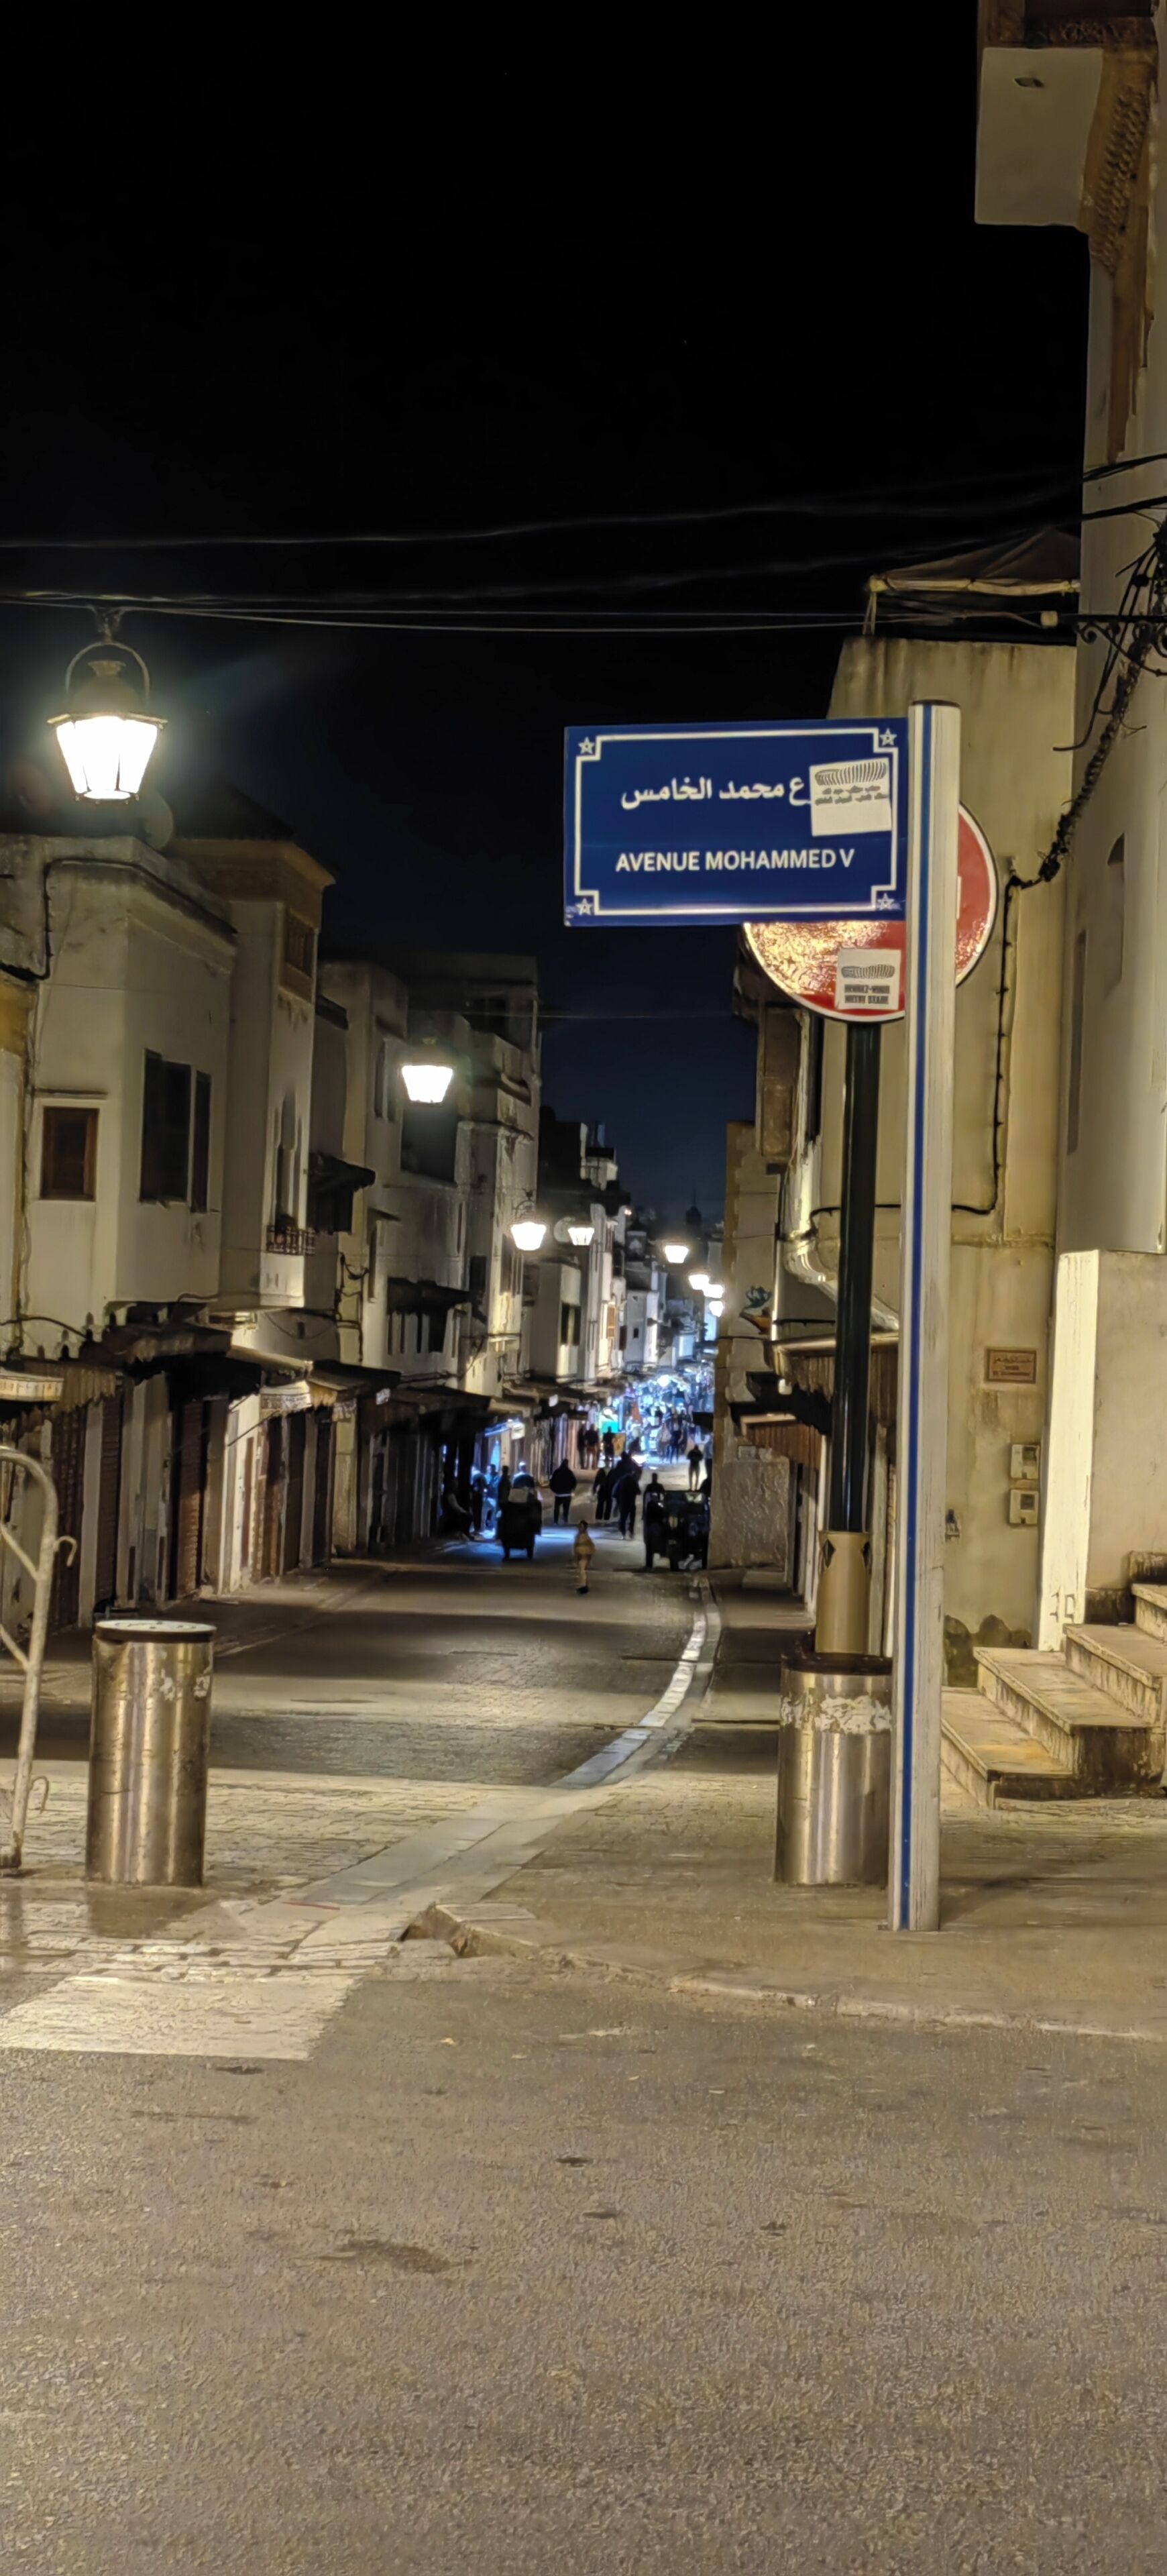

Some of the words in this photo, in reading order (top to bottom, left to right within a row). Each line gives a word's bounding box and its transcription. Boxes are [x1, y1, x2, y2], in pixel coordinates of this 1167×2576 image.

[620, 776, 713, 810] الخامس
[718, 781, 785, 800] محمد
[615, 851, 700, 872] AVENUE
[705, 849, 837, 871] MOHAMMED
[839, 848, 855, 867] V
